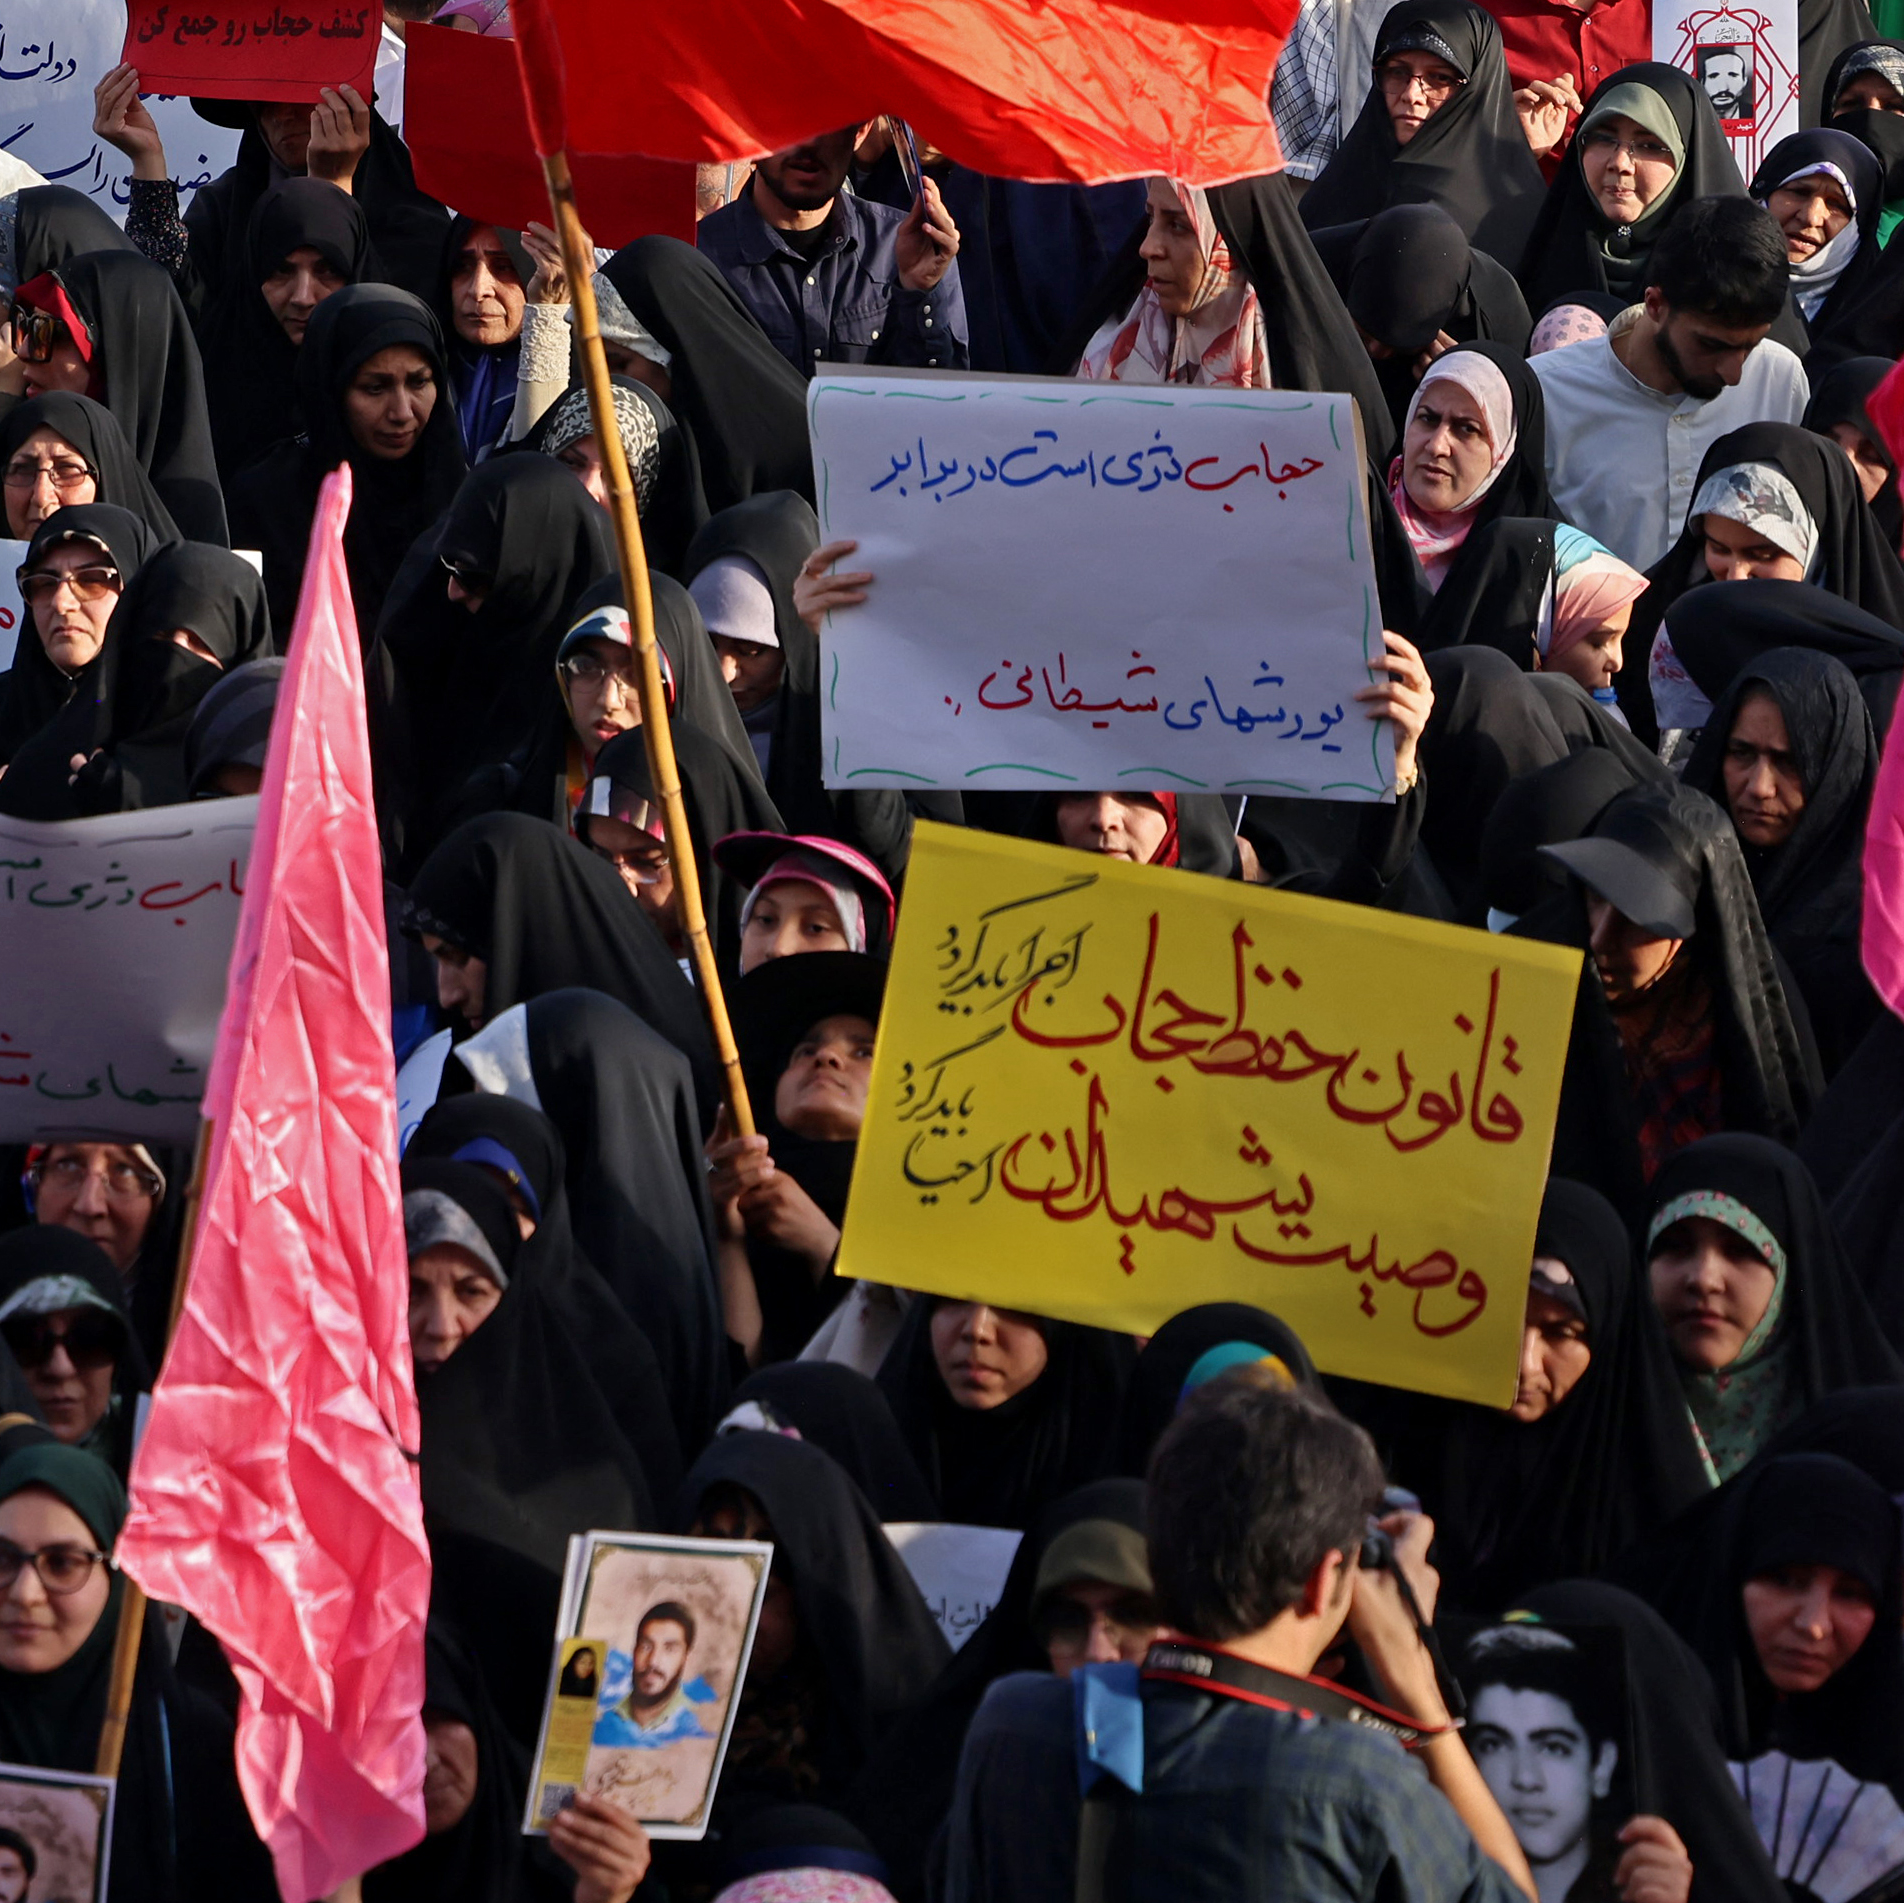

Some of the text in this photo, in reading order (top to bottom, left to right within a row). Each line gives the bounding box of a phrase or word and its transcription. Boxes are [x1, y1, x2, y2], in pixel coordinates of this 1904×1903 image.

[137, 4, 369, 47] کشف حجاب رو جمع کن
[997, 429, 1097, 489] است
[1100, 428, 1184, 493] دژی
[1184, 442, 1326, 512] حجاب
[976, 649, 1160, 730] شیطانی
[138, 858, 245, 926] اب
[1010, 911, 1526, 1152] قانون حفظ حجاب
[1231, 1221, 1491, 1339] وصیت
